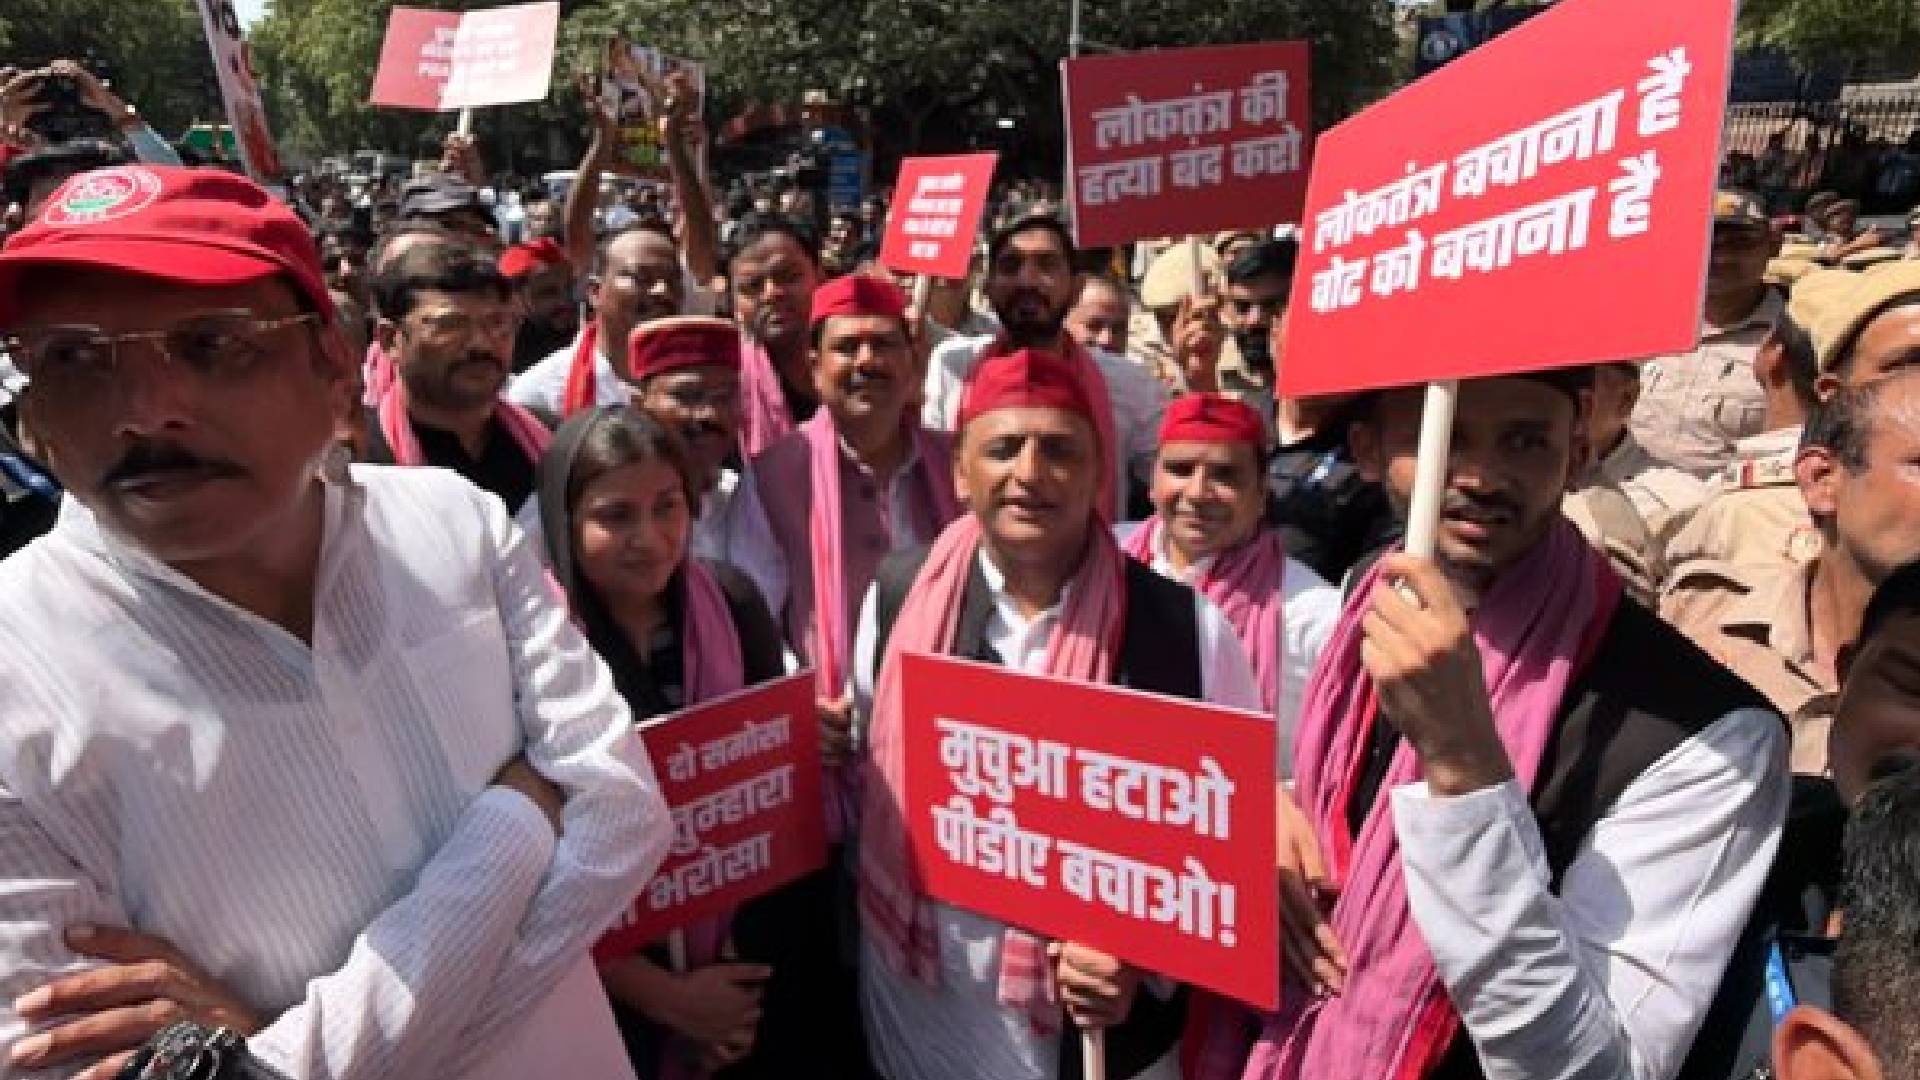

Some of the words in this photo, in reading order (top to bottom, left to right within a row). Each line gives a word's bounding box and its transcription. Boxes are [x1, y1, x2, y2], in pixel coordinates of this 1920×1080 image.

[1092, 83, 1234, 147] लोकतंत्र
[1240, 70, 1287, 125] की
[1314, 161, 1448, 254] लोकतंत्र
[1453, 88, 1625, 200] बचाना
[1637, 46, 1693, 137] है
[1078, 156, 1163, 205] हत्या
[1170, 137, 1224, 187] बंद
[1231, 121, 1303, 178] करो
[1311, 255, 1367, 315] वोट
[1371, 229, 1428, 296] को
[1431, 186, 1598, 280] बचाना
[1608, 148, 1661, 239] है
[665, 742, 698, 782] दो
[933, 717, 1072, 803] मुचुआ
[1075, 748, 1236, 840] हटाओ
[650, 830, 774, 911] भरोसा
[930, 794, 1052, 888] पीडीए
[1056, 838, 1237, 948] बचाओ!
